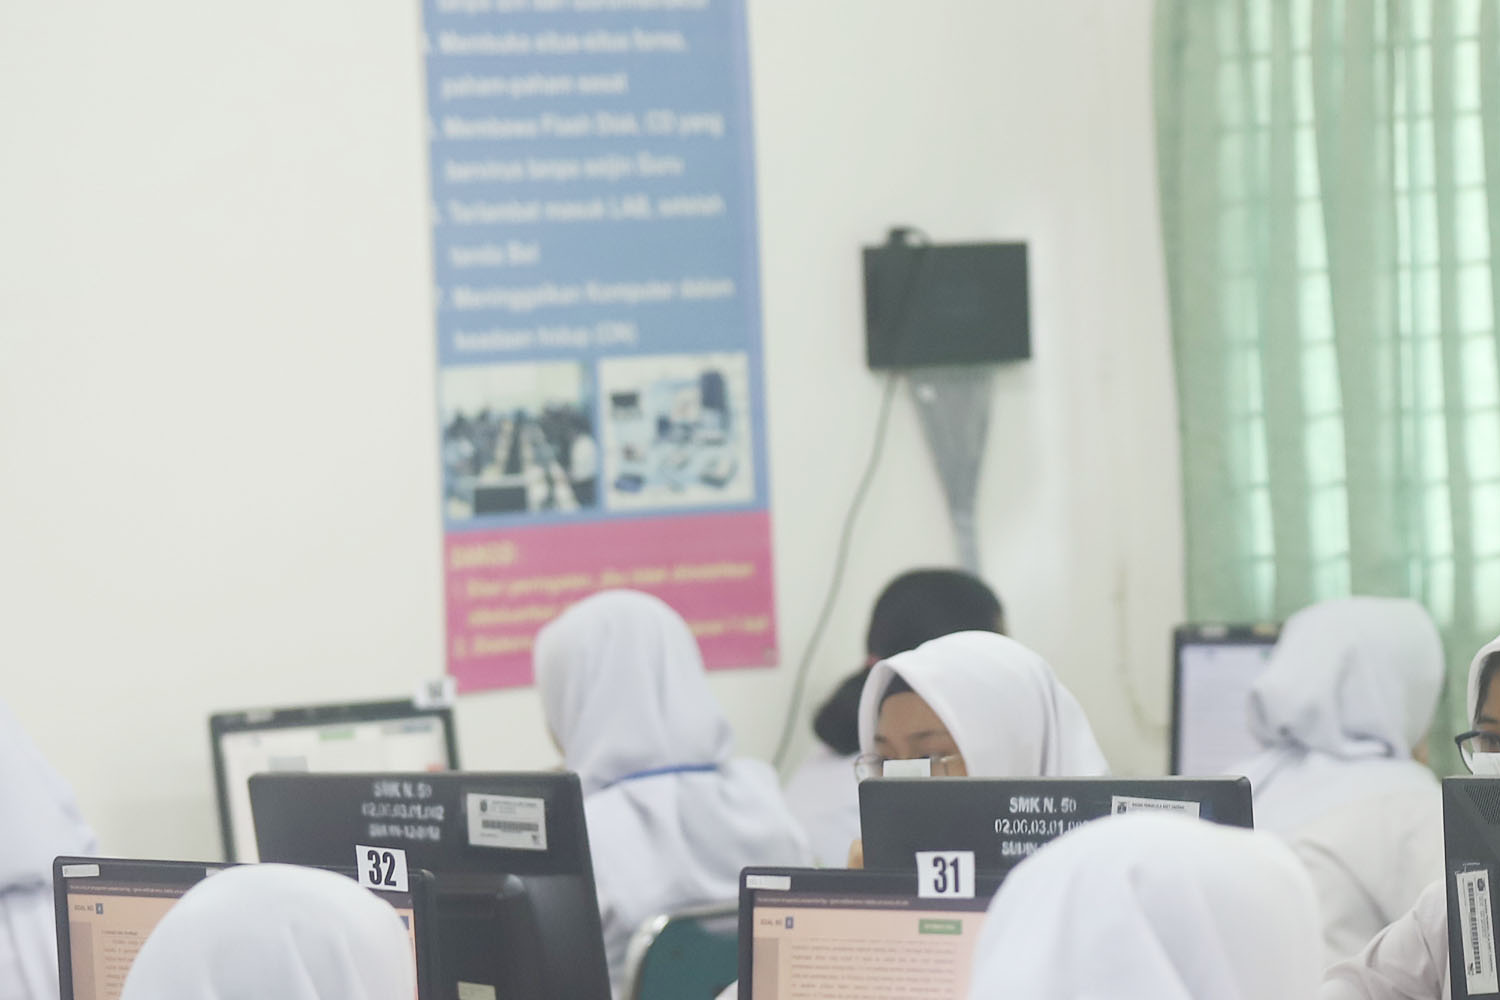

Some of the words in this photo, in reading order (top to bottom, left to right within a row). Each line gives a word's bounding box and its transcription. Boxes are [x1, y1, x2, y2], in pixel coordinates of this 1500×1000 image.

[1009, 797, 1039, 814] SMK
[1043, 798, 1057, 814] N.
[1061, 798, 1077, 814] 50
[367, 850, 397, 887] 32
[932, 857, 960, 893] 31
